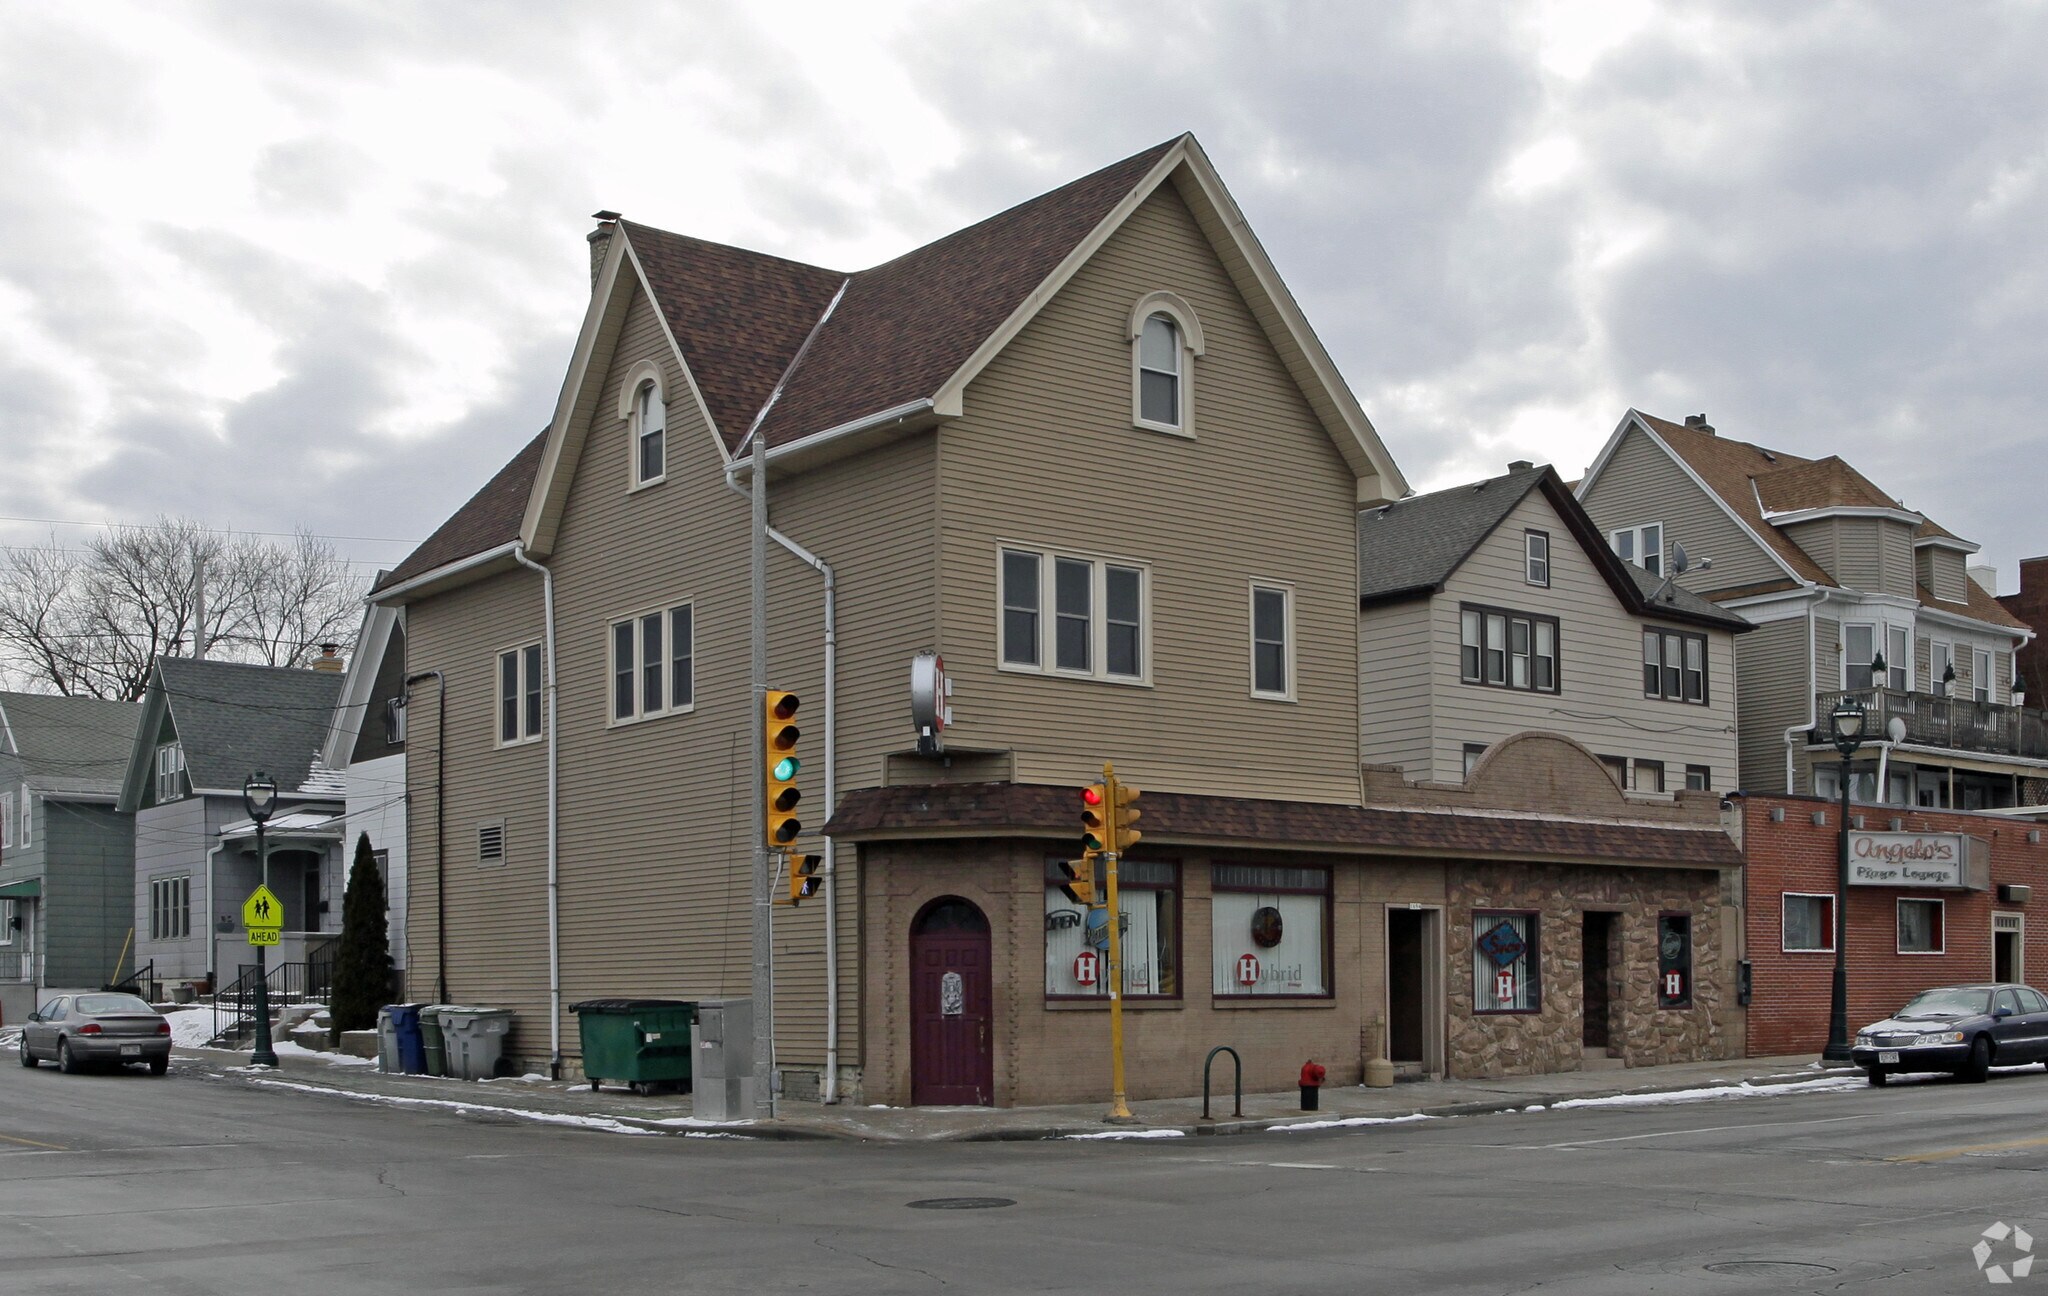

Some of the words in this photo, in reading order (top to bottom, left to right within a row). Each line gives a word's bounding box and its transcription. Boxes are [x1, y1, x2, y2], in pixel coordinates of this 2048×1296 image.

[1045, 910, 1081, 931] OPEN
[250, 932, 278, 942] AHEAD
[1239, 958, 1302, 984] Hybrid
[1496, 975, 1513, 998] H
[1666, 974, 1681, 995] H
